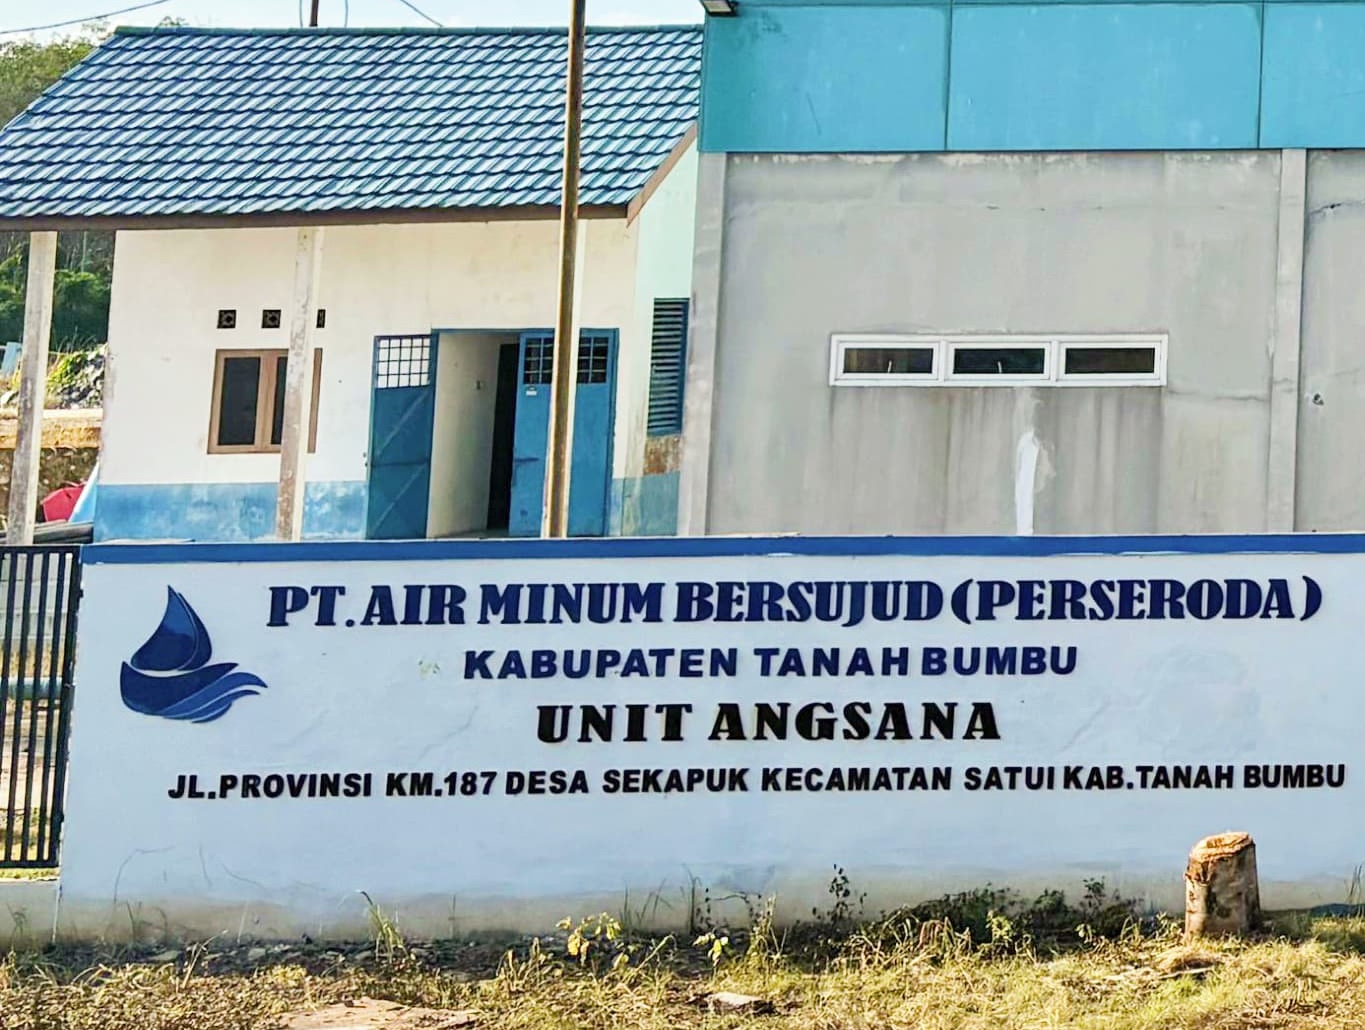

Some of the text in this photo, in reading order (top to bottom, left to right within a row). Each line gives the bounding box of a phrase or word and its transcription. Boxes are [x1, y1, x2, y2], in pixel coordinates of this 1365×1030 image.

[477, 582, 666, 625] MINUM
[673, 580, 944, 628] BERSUJUD
[950, 575, 1322, 625] (PERSERODA)
[463, 646, 1077, 680] KABUPATEN TANAH BUMBU
[537, 701, 1001, 744] UNIT ANGSANA
[385, 771, 498, 797] KM.187
[505, 769, 589, 796] DESA
[602, 767, 749, 794] SEKAPUK
[761, 766, 952, 792] KECAMATAN
[963, 766, 1055, 791] SATUI
[1243, 763, 1345, 789] BUMBU
